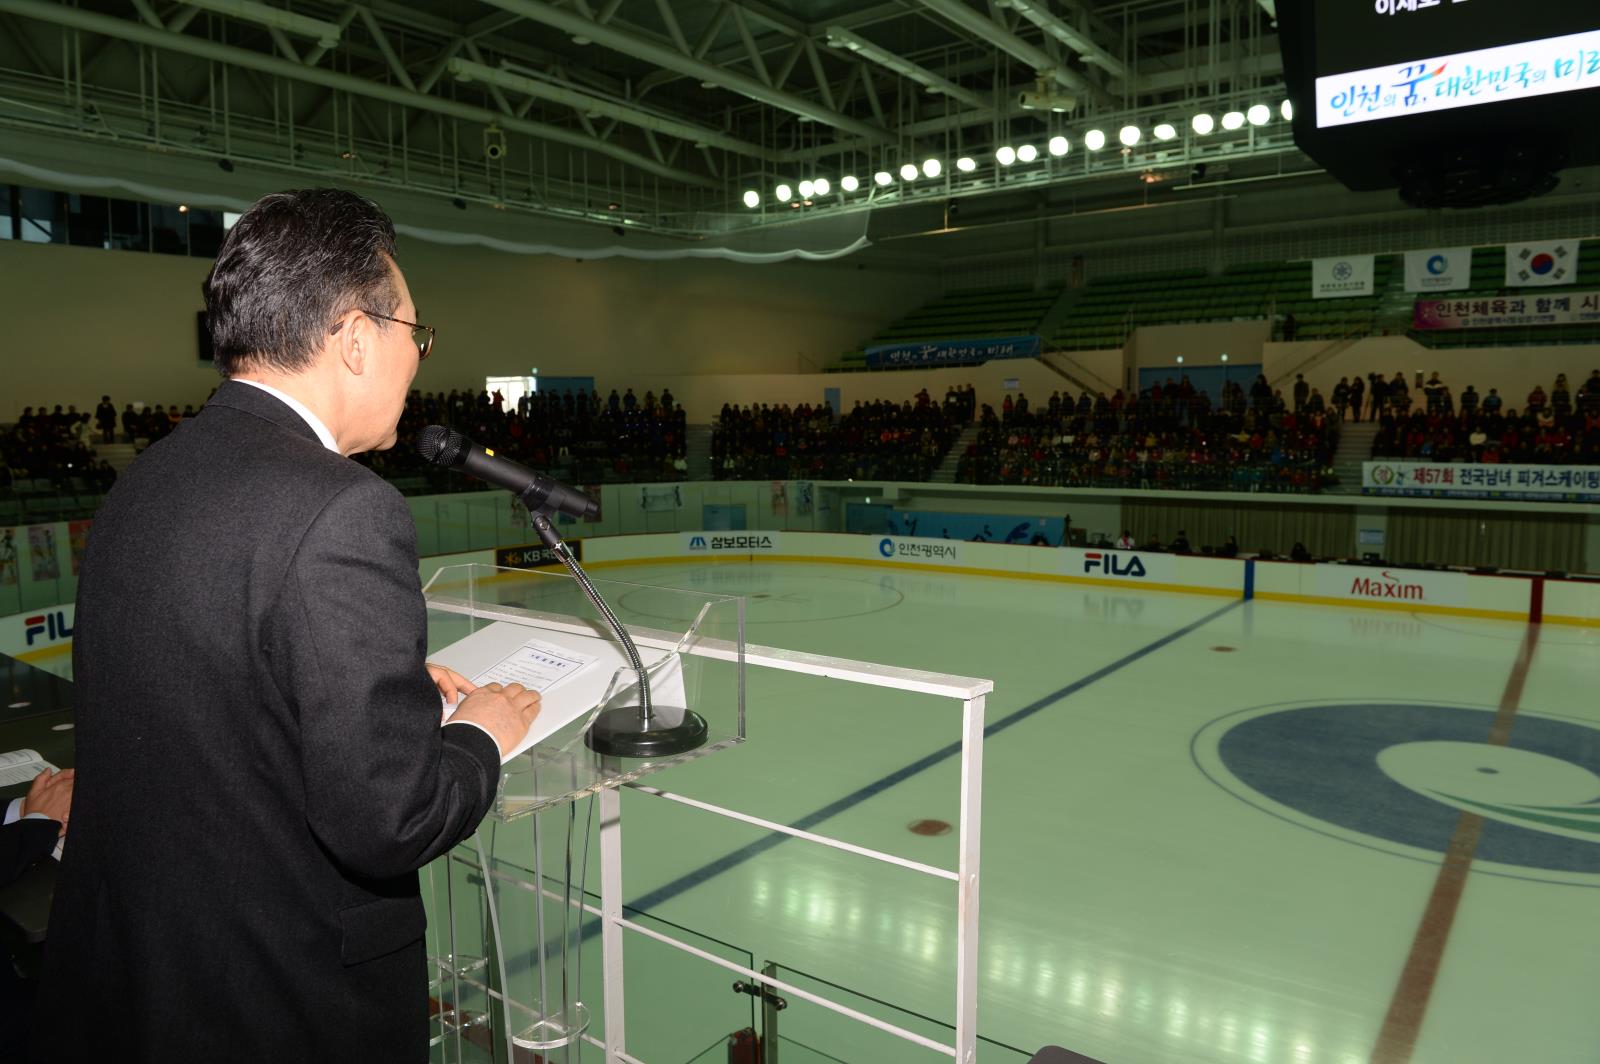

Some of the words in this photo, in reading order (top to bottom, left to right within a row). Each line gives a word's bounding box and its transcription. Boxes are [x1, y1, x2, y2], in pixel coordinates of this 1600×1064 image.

[1330, 84, 1396, 117] 인천의
[1435, 62, 1546, 97] 대한민국의
[1435, 298, 1526, 318] 인천체육과
[1536, 296, 1570, 313] 함께
[1413, 467, 1454, 484] 제57회
[1459, 468, 1512, 486] 전국남녀
[1517, 469, 1600, 489] 피겨스케이팅
[710, 536, 773, 549] 삼보모터스
[899, 542, 956, 559] 인천광역시
[1084, 553, 1146, 577] FILA
[1351, 576, 1423, 600] Maxim
[24, 611, 74, 646] FIL
